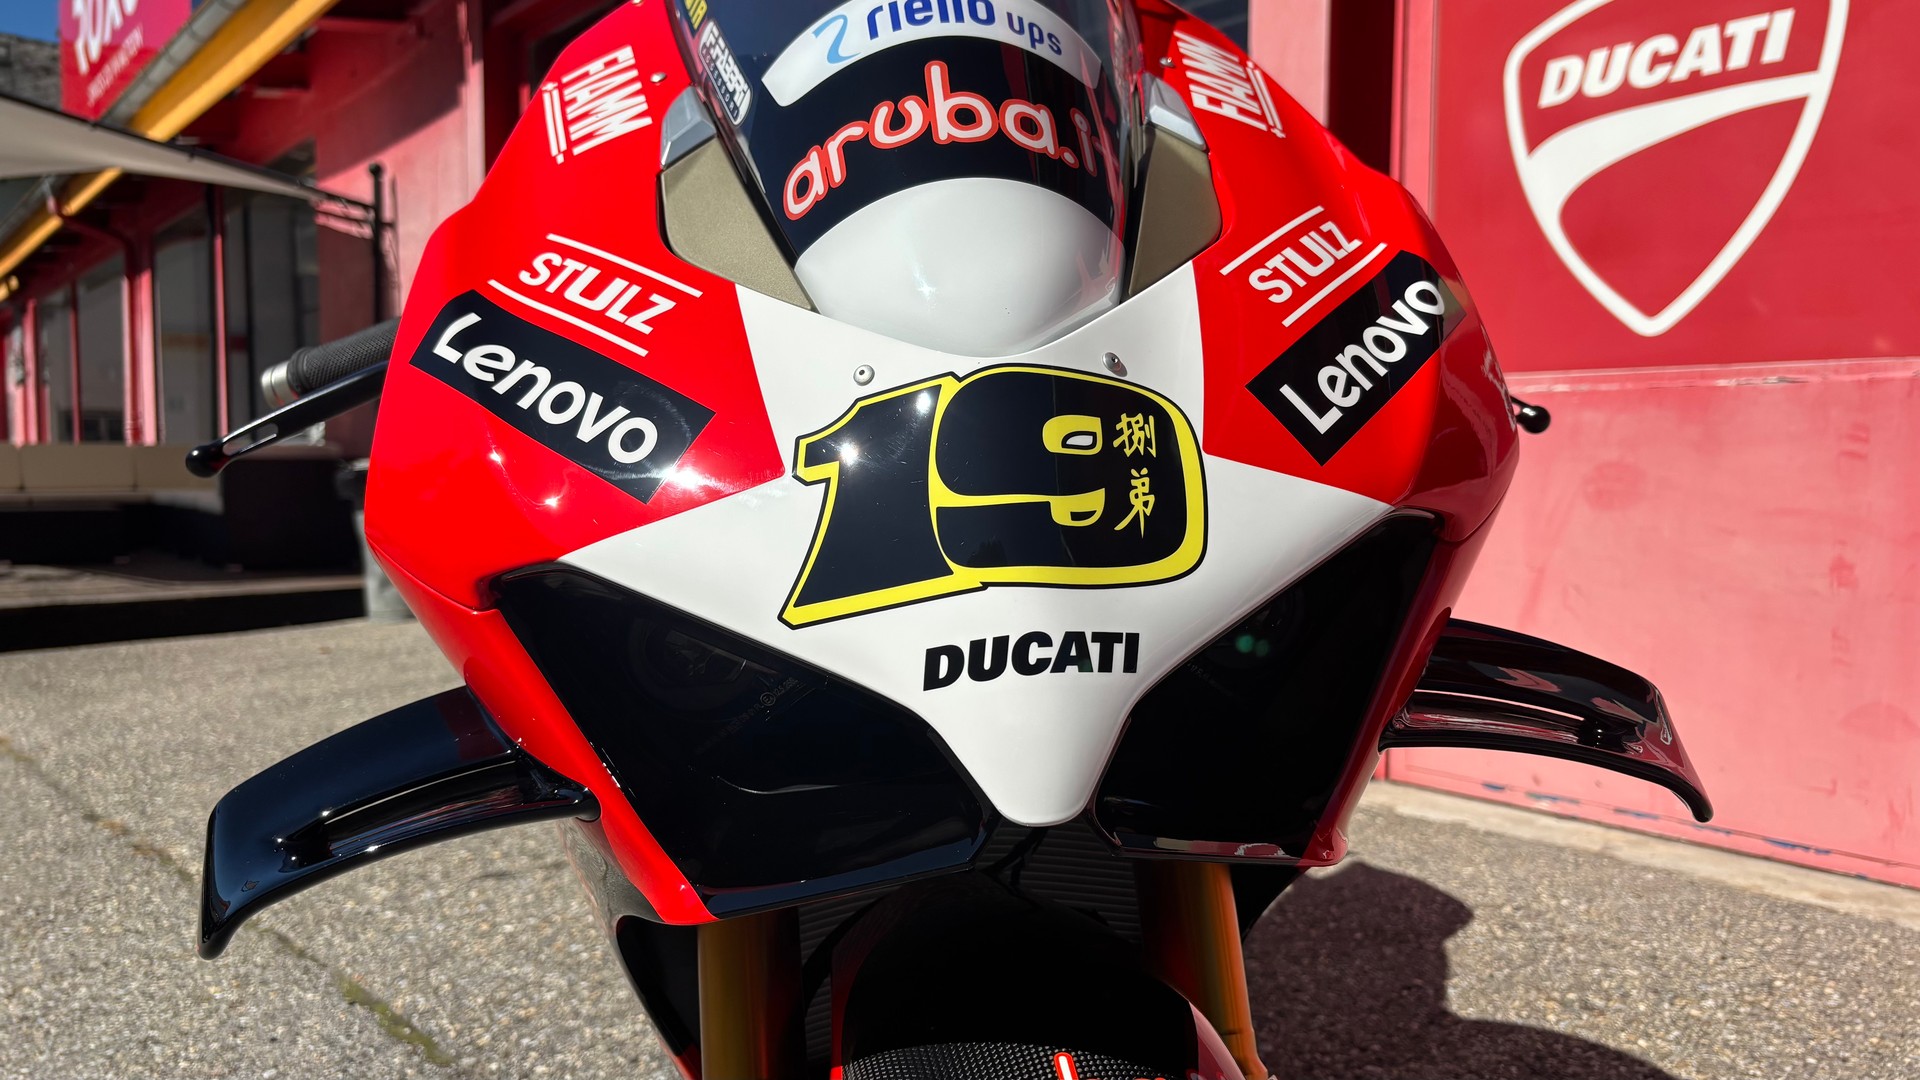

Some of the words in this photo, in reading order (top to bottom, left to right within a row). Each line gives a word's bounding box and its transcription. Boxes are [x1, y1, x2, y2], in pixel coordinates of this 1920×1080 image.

[867, 0, 996, 40] riello
[1006, 12, 1063, 56] ups
[1537, 7, 1796, 109] DUCATI
[560, 44, 653, 156] FIAMM
[1173, 30, 1268, 132] FIAMM
[783, 60, 1104, 219] aruba.i
[518, 252, 677, 335] STULZ
[1249, 220, 1363, 304] STULZ
[432, 312, 659, 464] Lenovo
[1279, 280, 1446, 435] Lenovo
[778, 363, 1208, 630] 19
[923, 631, 1140, 691] DUCATI
